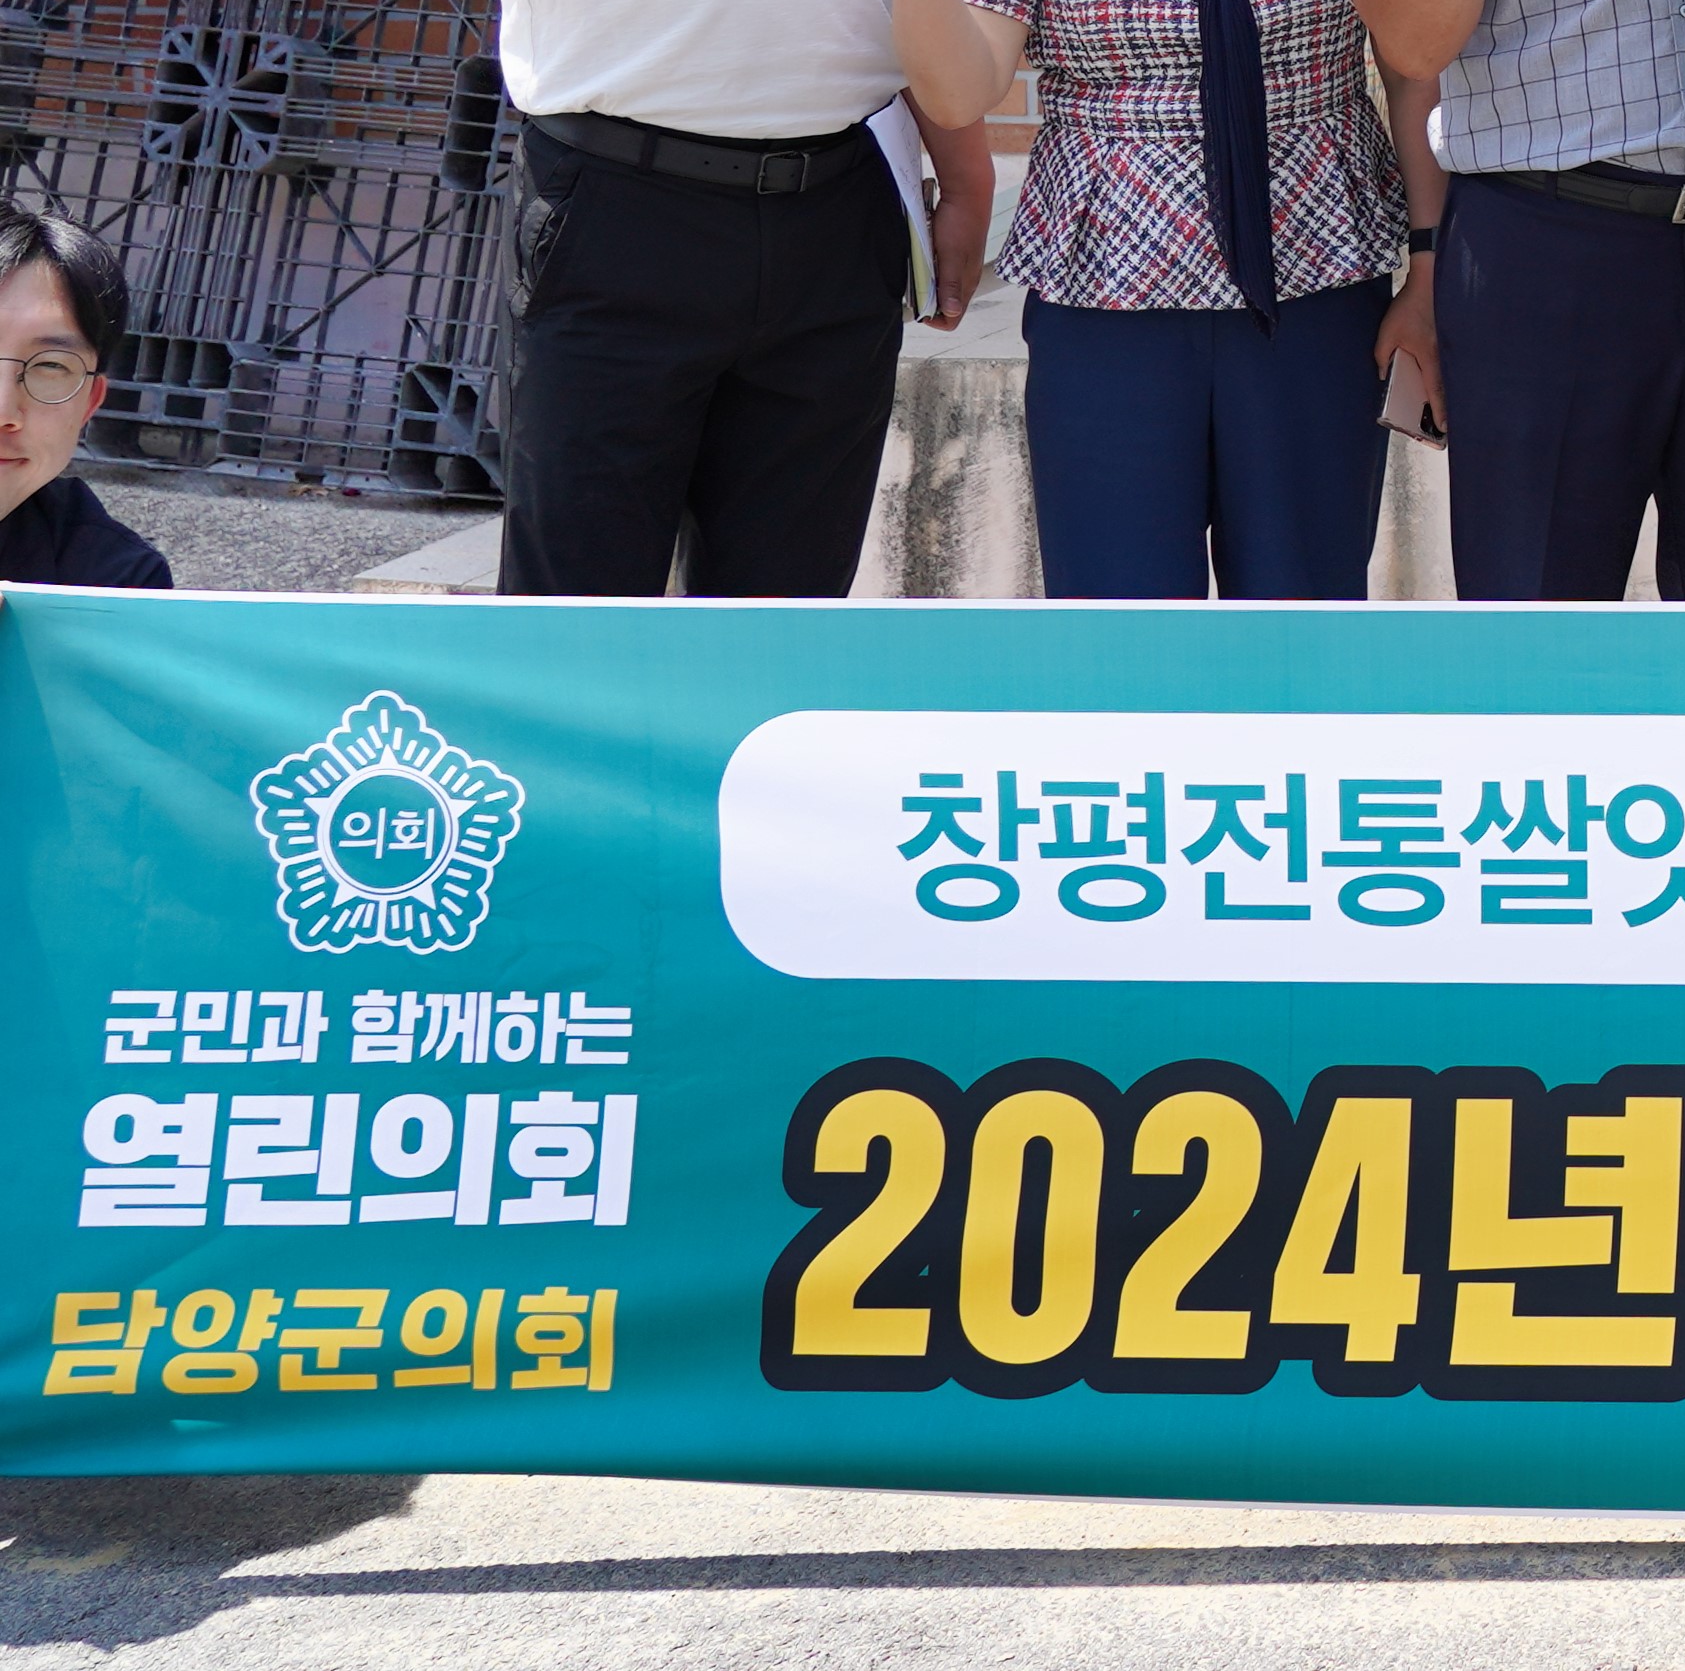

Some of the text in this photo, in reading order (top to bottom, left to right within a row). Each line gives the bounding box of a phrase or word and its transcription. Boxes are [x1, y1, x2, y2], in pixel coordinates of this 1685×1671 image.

[338, 806, 436, 861] 의회
[104, 990, 634, 1066] 군민과 함께하는
[78, 1091, 639, 1229] 열린의회
[43, 1287, 618, 1397] 담양군의회
